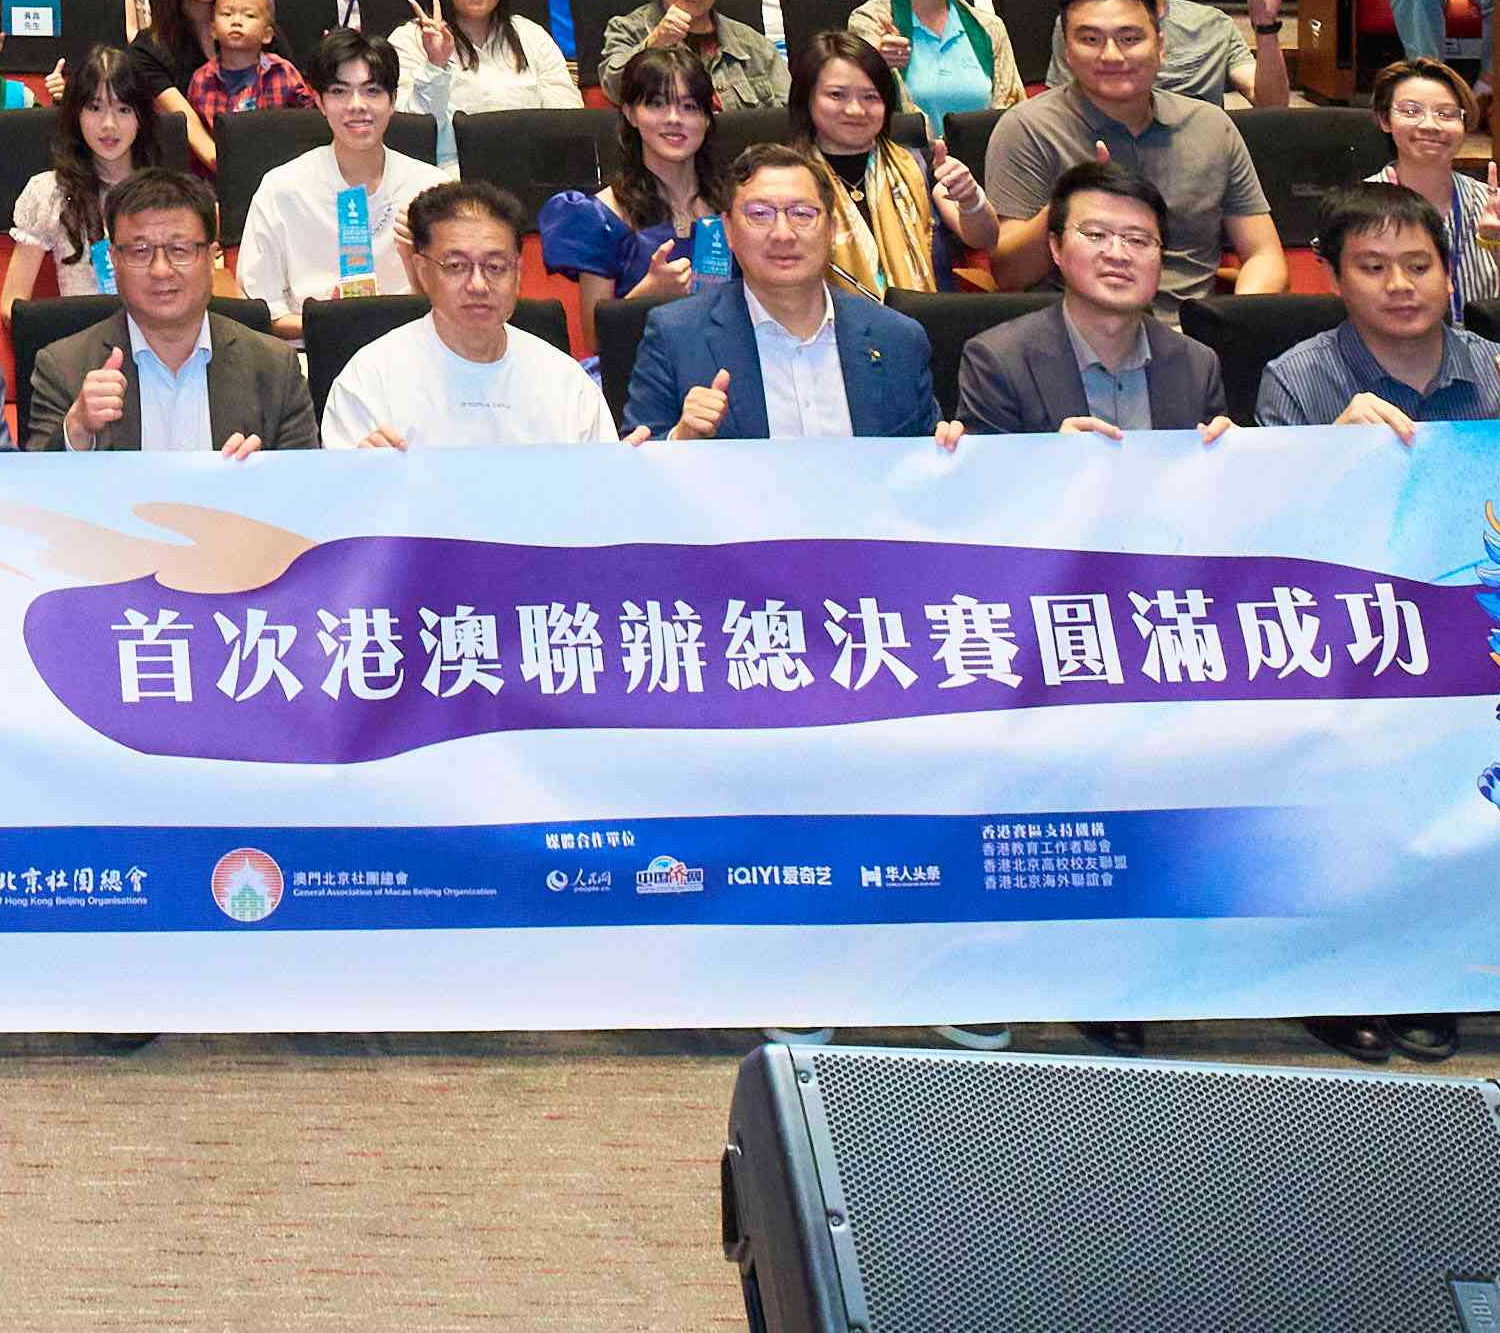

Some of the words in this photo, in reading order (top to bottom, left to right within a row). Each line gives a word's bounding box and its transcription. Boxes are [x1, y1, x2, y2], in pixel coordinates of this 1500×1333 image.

[110, 589, 1432, 704] 首次港澳聯辦總決賽圓滿成功
[727, 866, 780, 885] iQIYI
[782, 866, 832, 885] 爱奇艺
[292, 888, 326, 897] General
[327, 888, 373, 897] Association
[374, 887, 383, 896] of
[384, 888, 412, 896] Macau
[413, 888, 442, 898] Beijing
[443, 887, 497, 898] Organization
[4, 897, 29, 907] Hong
[30, 897, 54, 908] Kong
[55, 896, 86, 908] Beijing
[87, 896, 148, 907] Organisations
